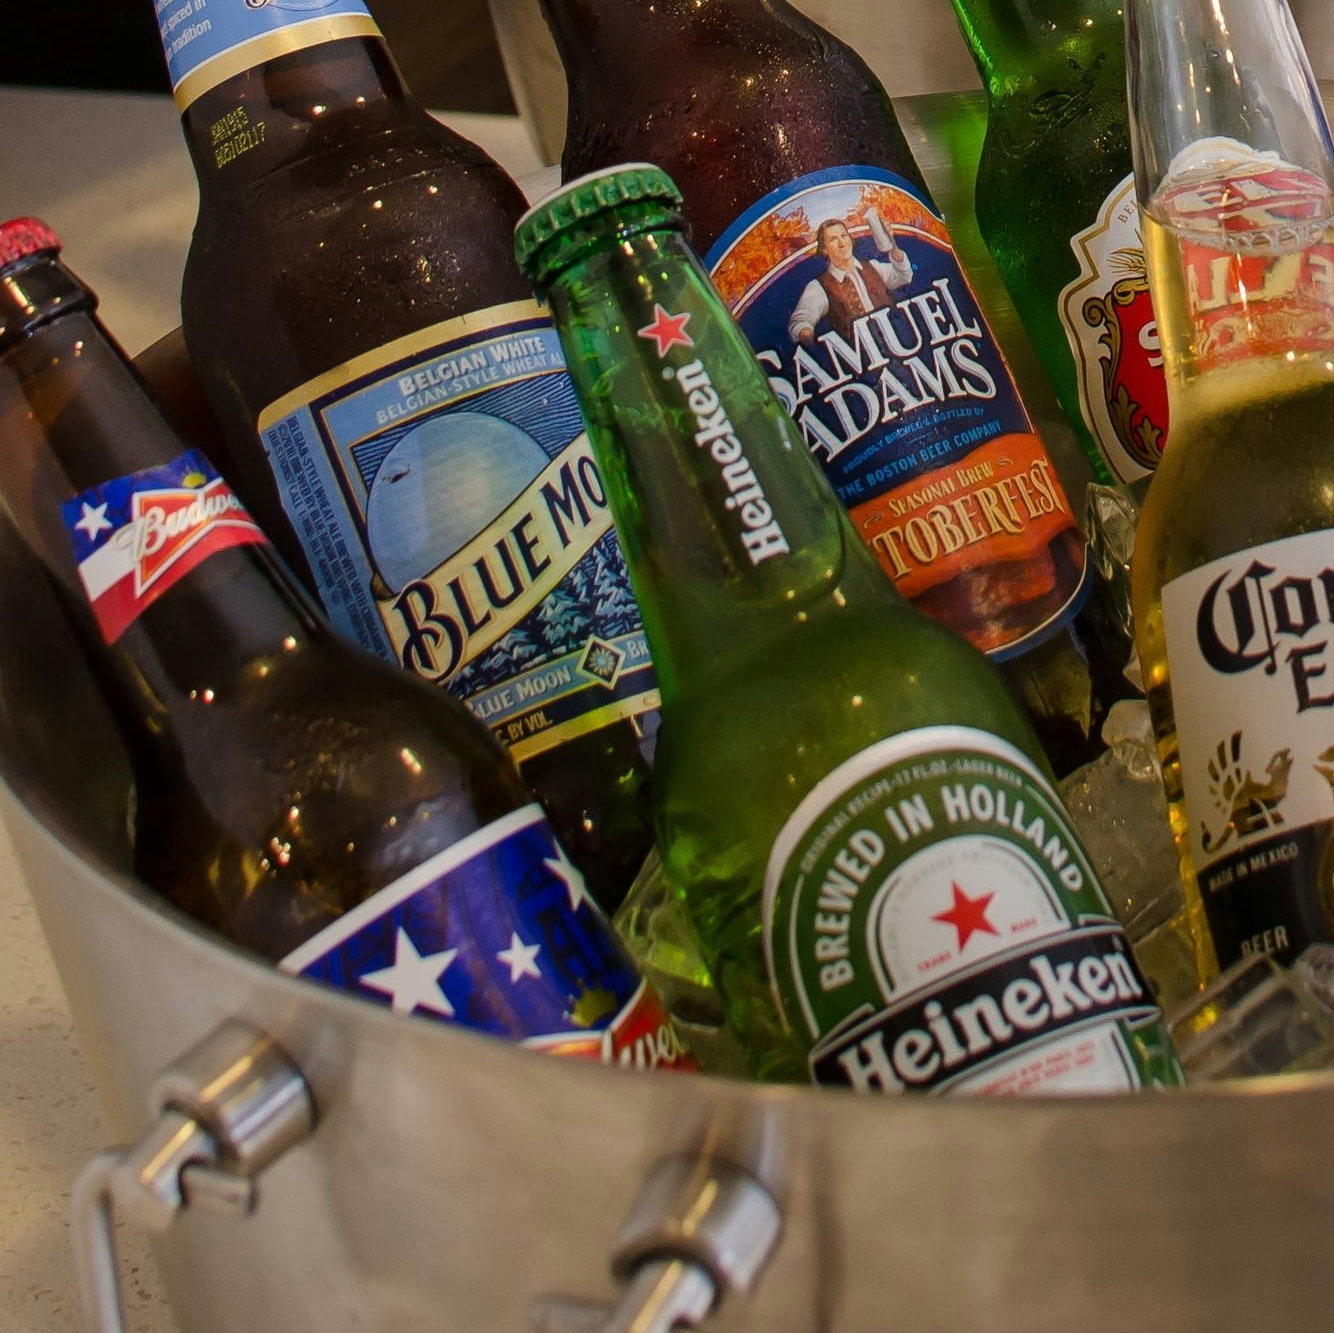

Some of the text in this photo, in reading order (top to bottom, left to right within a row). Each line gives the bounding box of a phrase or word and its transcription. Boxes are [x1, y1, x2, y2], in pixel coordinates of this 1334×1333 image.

[375, 366, 500, 424] BELGIAN-STYLE
[501, 353, 549, 376] WHEAT
[398, 336, 546, 397] BELGIAN WHITE
[757, 278, 983, 419] SAMUEL
[800, 339, 997, 464] ADAMS
[842, 440, 884, 475] PROUDLY
[932, 406, 973, 424] BOTTLED
[675, 358, 792, 566] Heineken
[837, 419, 1003, 500] THE BOSTON BEER COMPANY
[888, 460, 995, 517] SEASONAL BREW
[871, 456, 1066, 582] TOBERFEST
[390, 512, 552, 684] BLUE
[515, 664, 573, 702] MOON
[508, 722, 524, 740] BY
[813, 829, 887, 993] BREWED
[884, 792, 936, 844] IN
[940, 782, 1086, 893] HOLLAND
[1240, 924, 1290, 958] BEER
[837, 947, 1145, 1094] Heineken
